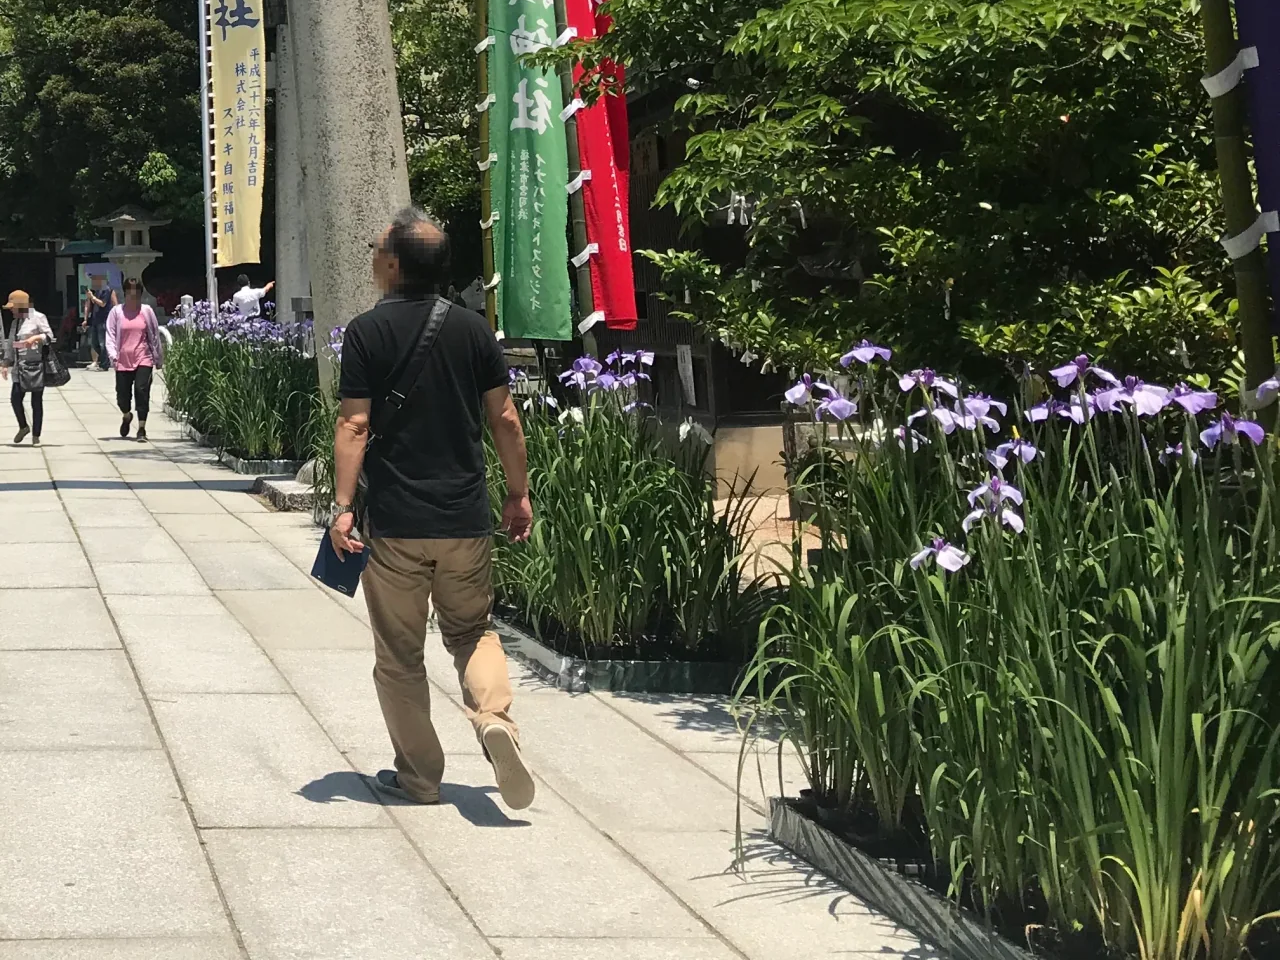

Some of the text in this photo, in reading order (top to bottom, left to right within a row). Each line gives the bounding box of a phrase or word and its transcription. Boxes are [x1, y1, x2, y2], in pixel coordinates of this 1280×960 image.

[235, 62, 247, 129] 株式会社
[247, 47, 261, 187] 平成二十六年九月吉日
